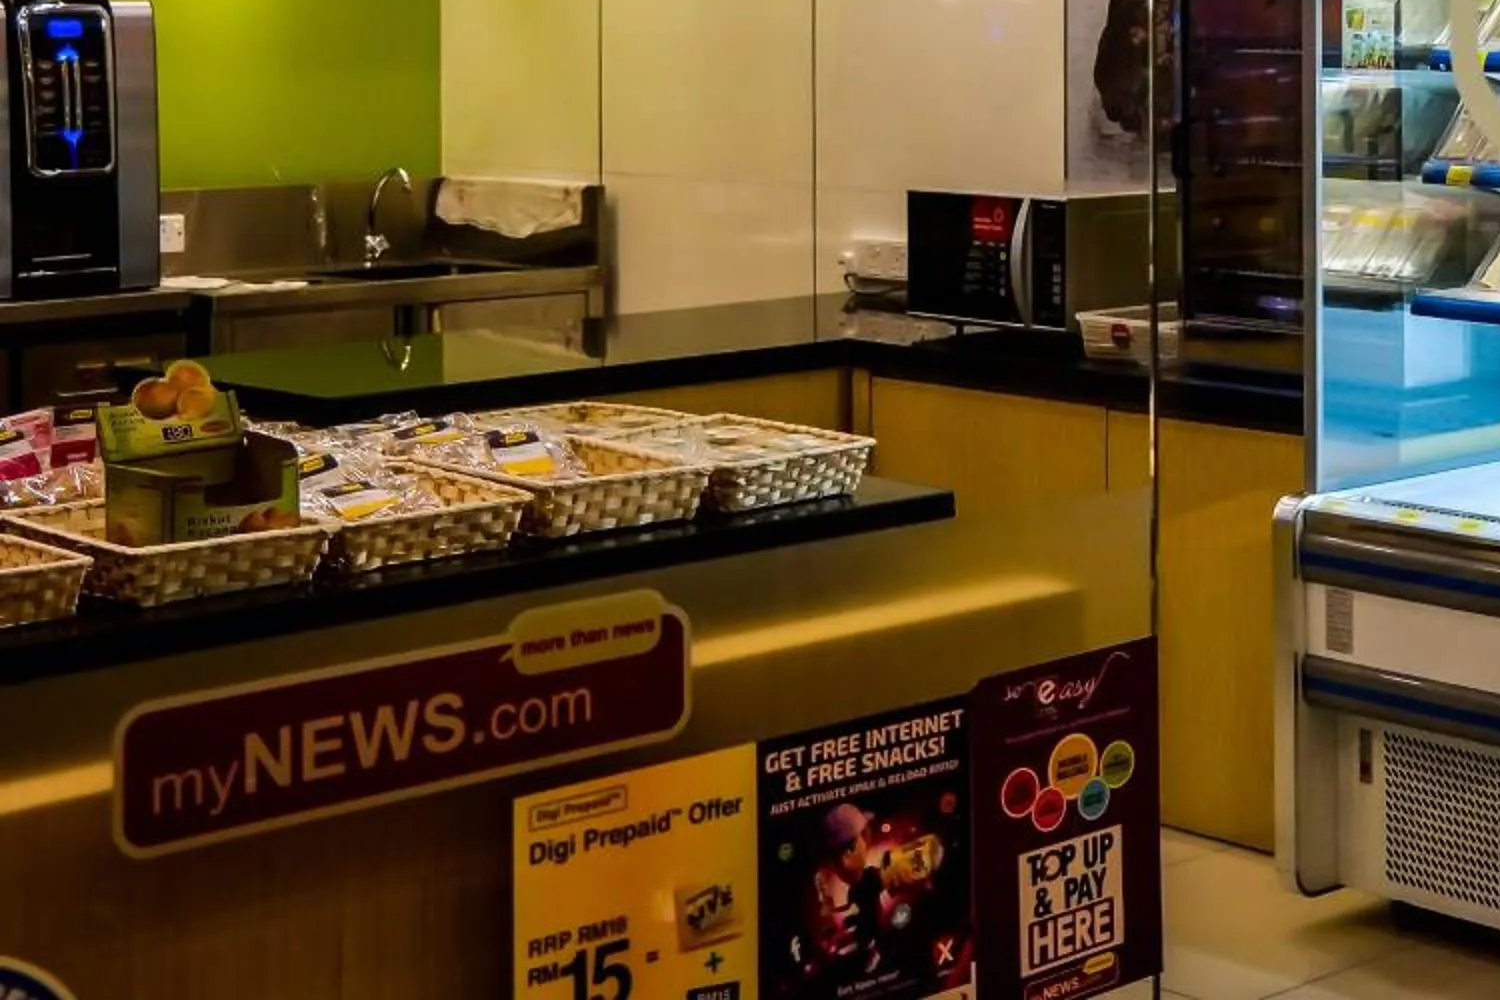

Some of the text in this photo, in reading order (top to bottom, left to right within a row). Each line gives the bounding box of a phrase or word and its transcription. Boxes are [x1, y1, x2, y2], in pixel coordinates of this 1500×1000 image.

[153, 687, 592, 815] myNEWS.com
[764, 708, 967, 774] GET FREE INTERNET
[784, 735, 946, 793] & FREE SNACKS!
[529, 834, 576, 866] Digi
[688, 797, 743, 825] Offer
[1027, 832, 1114, 886] TOP UP
[1034, 867, 1107, 917] & PAY
[528, 931, 572, 959] RRP
[1031, 900, 1112, 966] HERE
